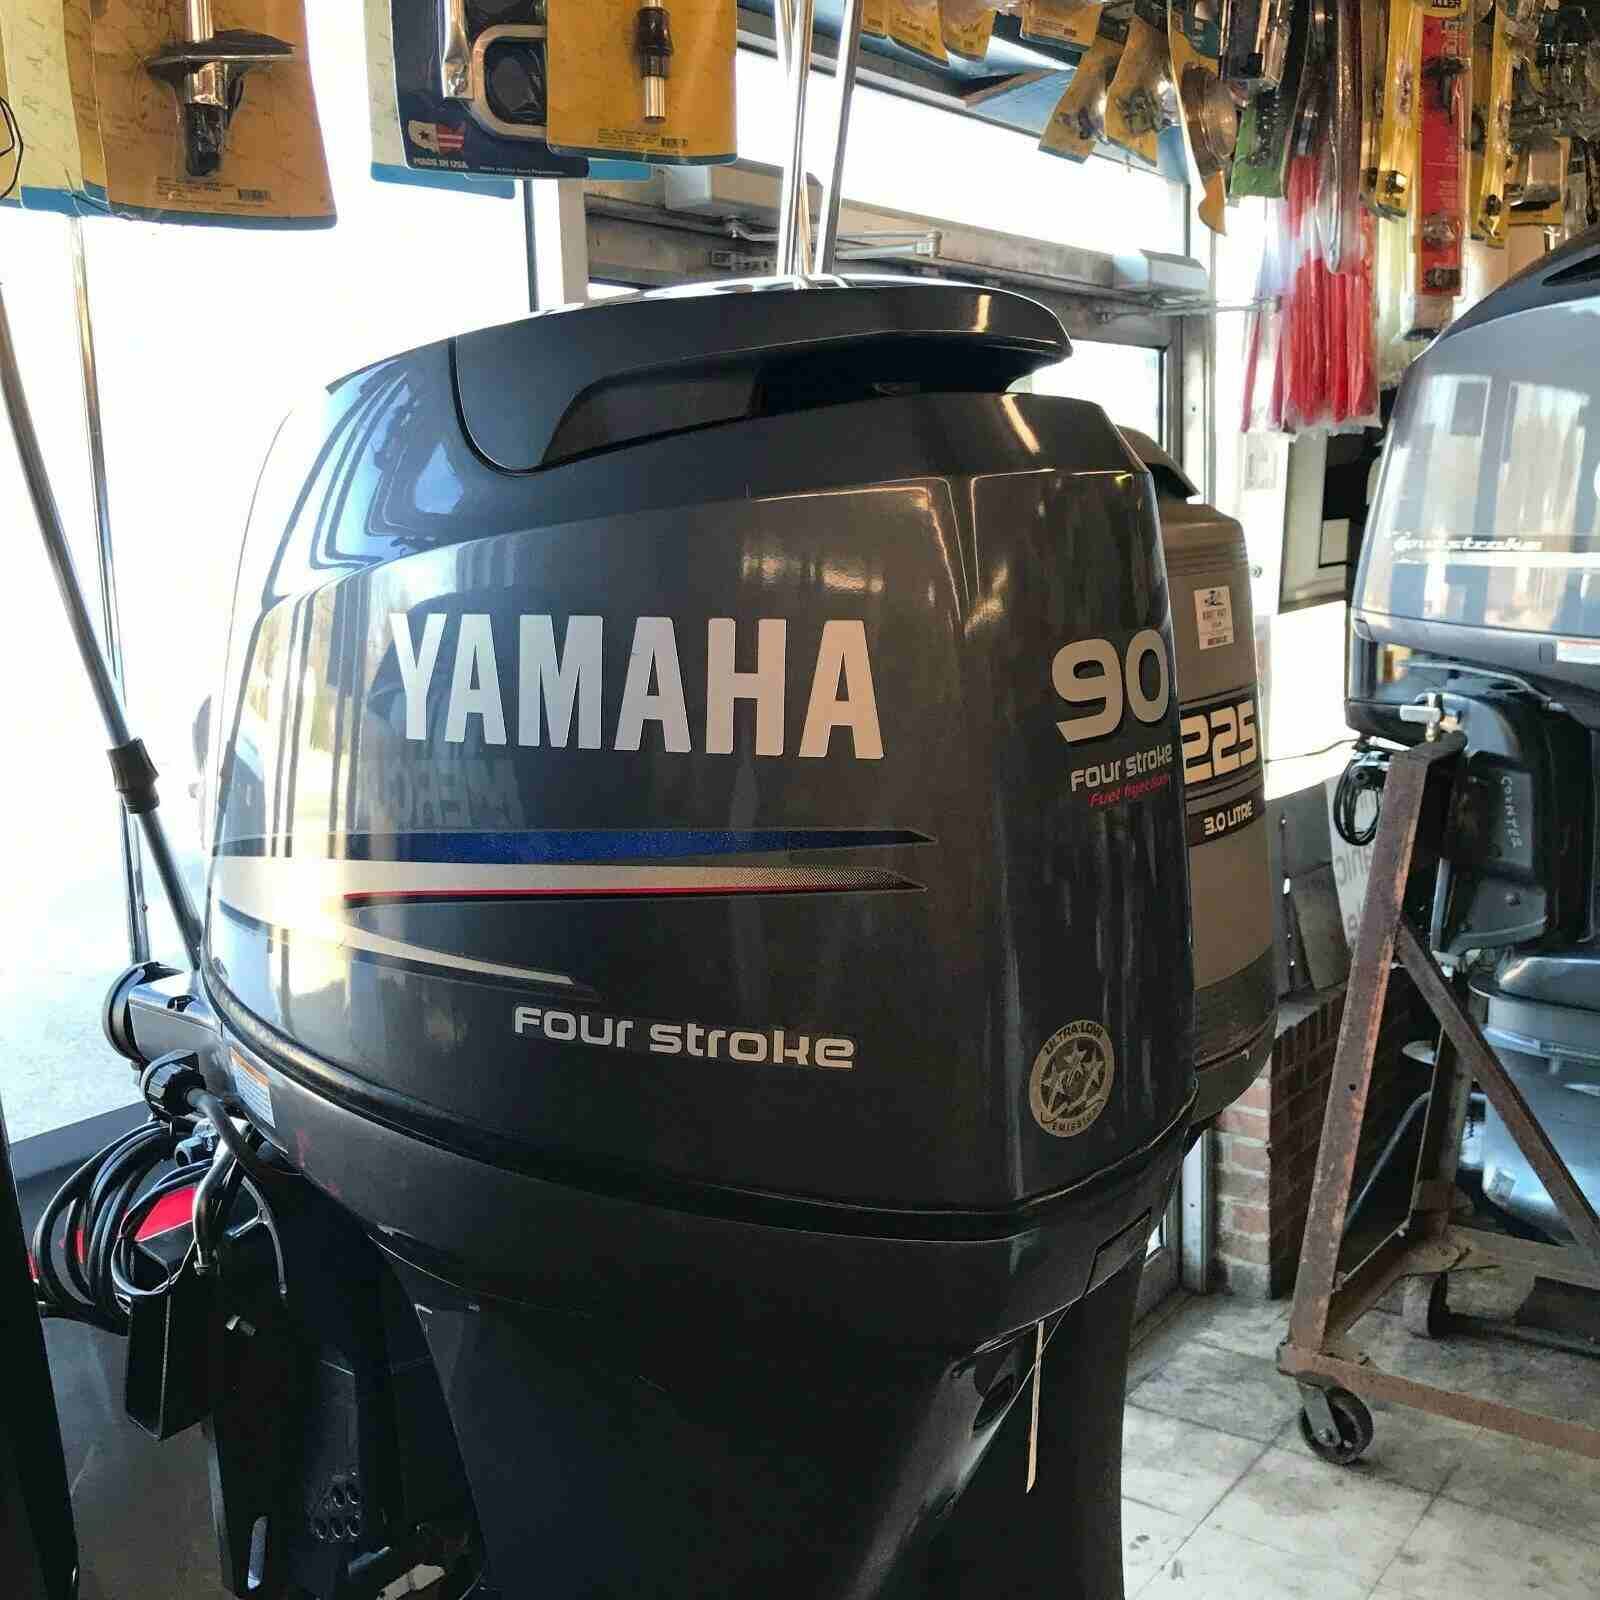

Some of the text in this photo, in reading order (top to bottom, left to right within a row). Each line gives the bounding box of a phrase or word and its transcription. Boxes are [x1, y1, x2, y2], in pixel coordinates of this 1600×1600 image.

[389, 612, 884, 760] YAMAHA
[1051, 629, 1170, 743] 90
[1180, 700, 1258, 785] 225
[1203, 800, 1254, 835] 3.0 LITRE
